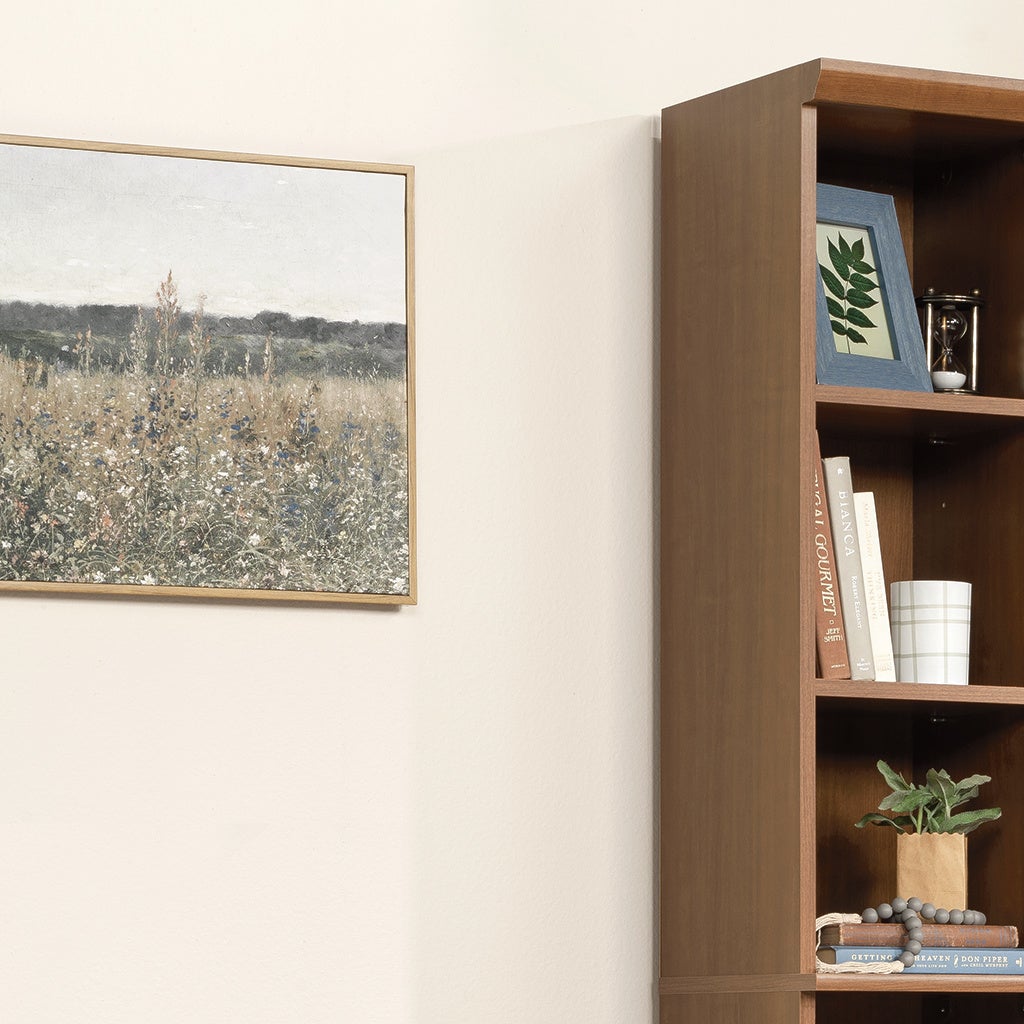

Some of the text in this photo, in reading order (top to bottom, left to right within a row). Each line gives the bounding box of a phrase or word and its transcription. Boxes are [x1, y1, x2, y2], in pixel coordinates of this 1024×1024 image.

[838, 491, 855, 557] BIANCA
[814, 533, 837, 616] GOURMET
[851, 953, 894, 961] GETTING
[962, 955, 981, 963] DON
